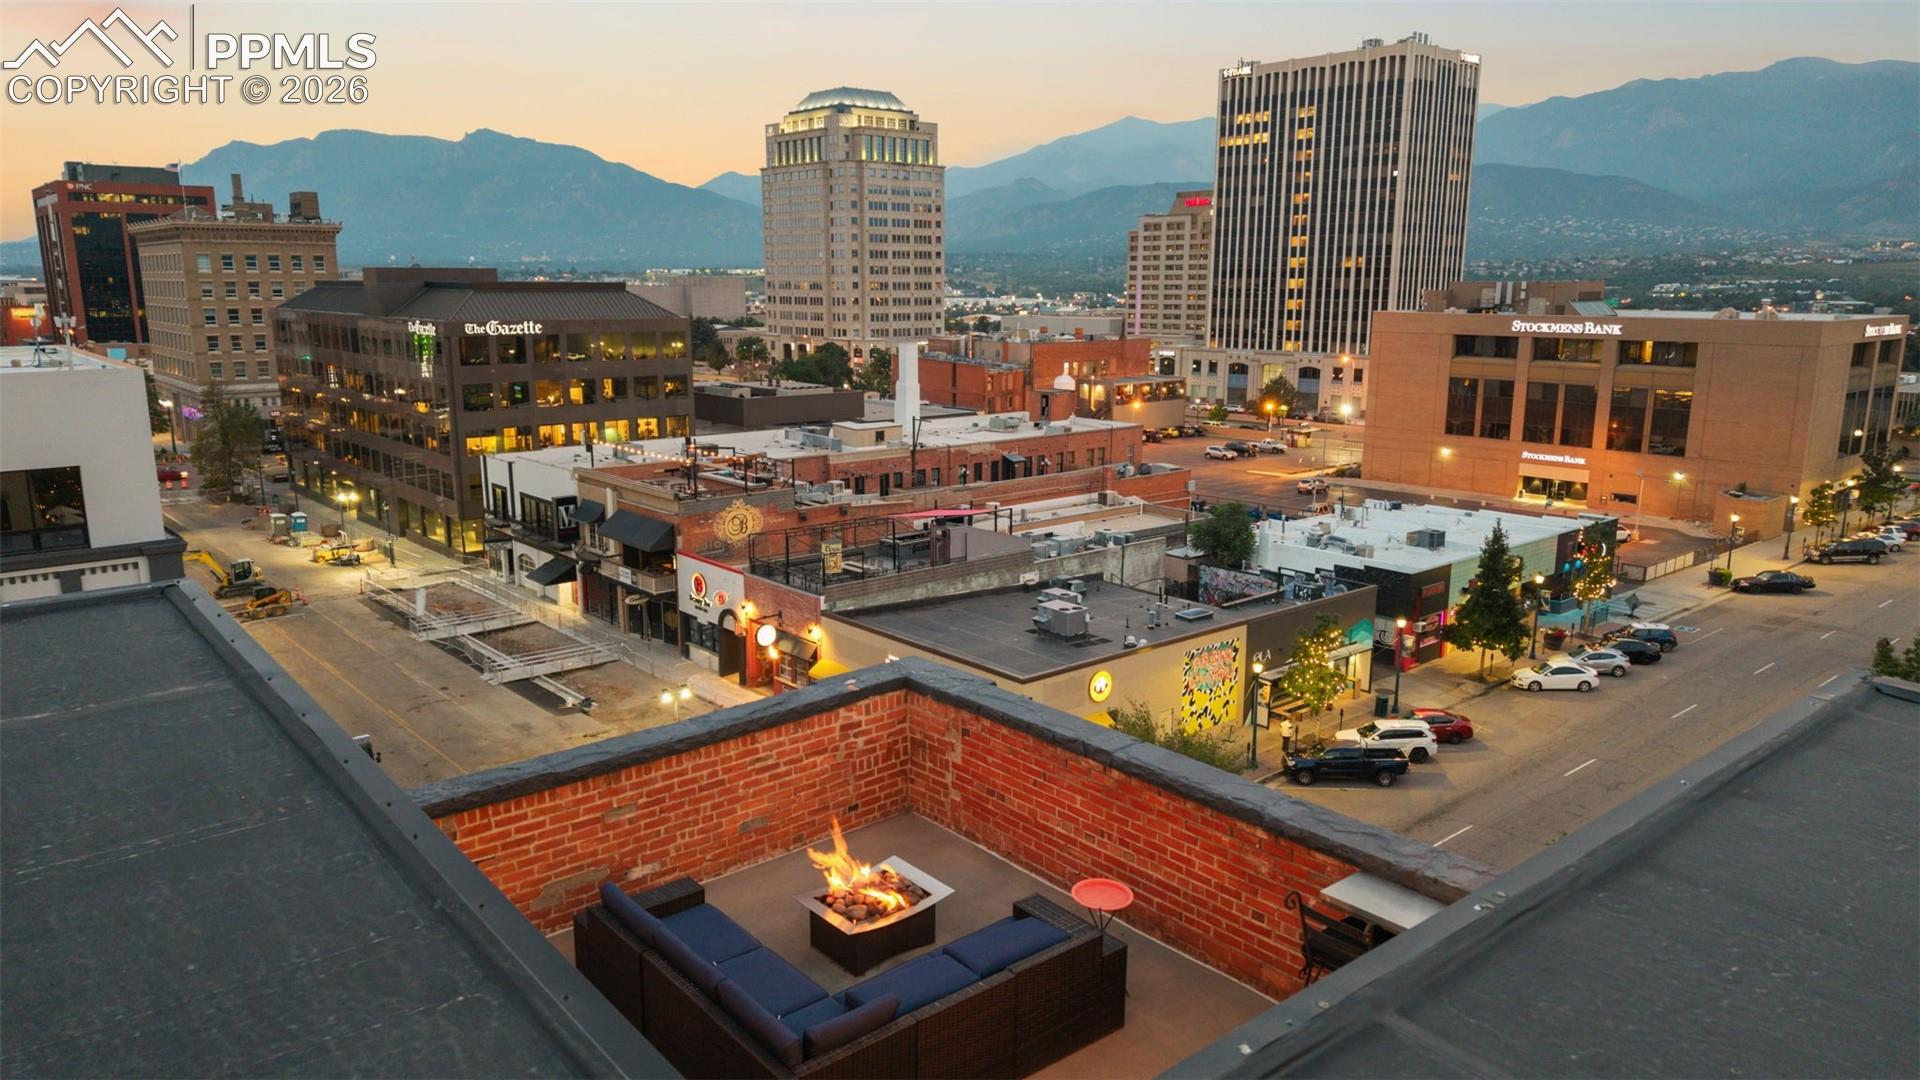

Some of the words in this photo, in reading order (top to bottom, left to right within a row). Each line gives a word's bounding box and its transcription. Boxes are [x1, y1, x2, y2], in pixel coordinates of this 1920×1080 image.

[464, 322, 486, 335] The
[485, 319, 543, 336] Gazette
[1511, 320, 1584, 334] STOCKMENS
[1584, 321, 1623, 336] BANK
